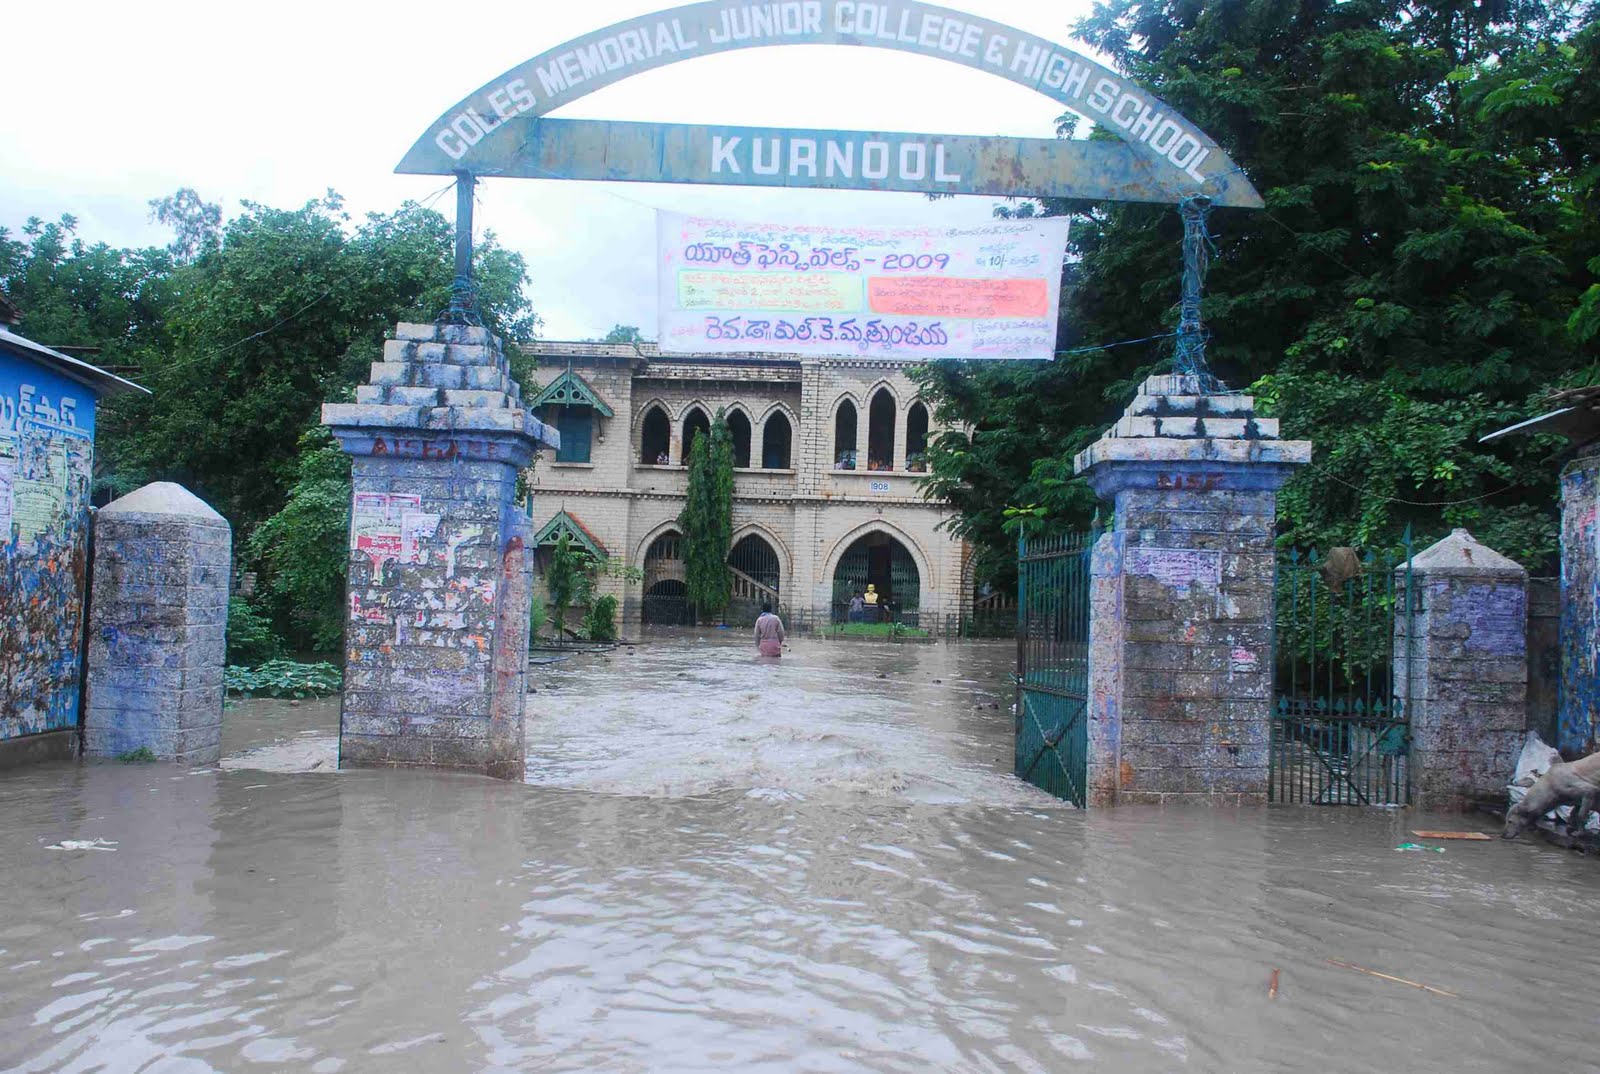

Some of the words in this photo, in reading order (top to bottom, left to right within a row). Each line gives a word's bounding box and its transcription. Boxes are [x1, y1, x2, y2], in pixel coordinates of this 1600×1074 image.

[435, 78, 536, 161] COLES
[536, 18, 698, 98] MEMORIAL
[709, 0, 822, 44] JUNIOR
[834, 1, 982, 58] COLLEGE
[1010, 39, 1091, 100] HIGH
[1087, 78, 1211, 184] SCHOOL
[711, 135, 961, 183] KURNOOL
[883, 253, 950, 270] 2009
[871, 482, 889, 491] 1908
